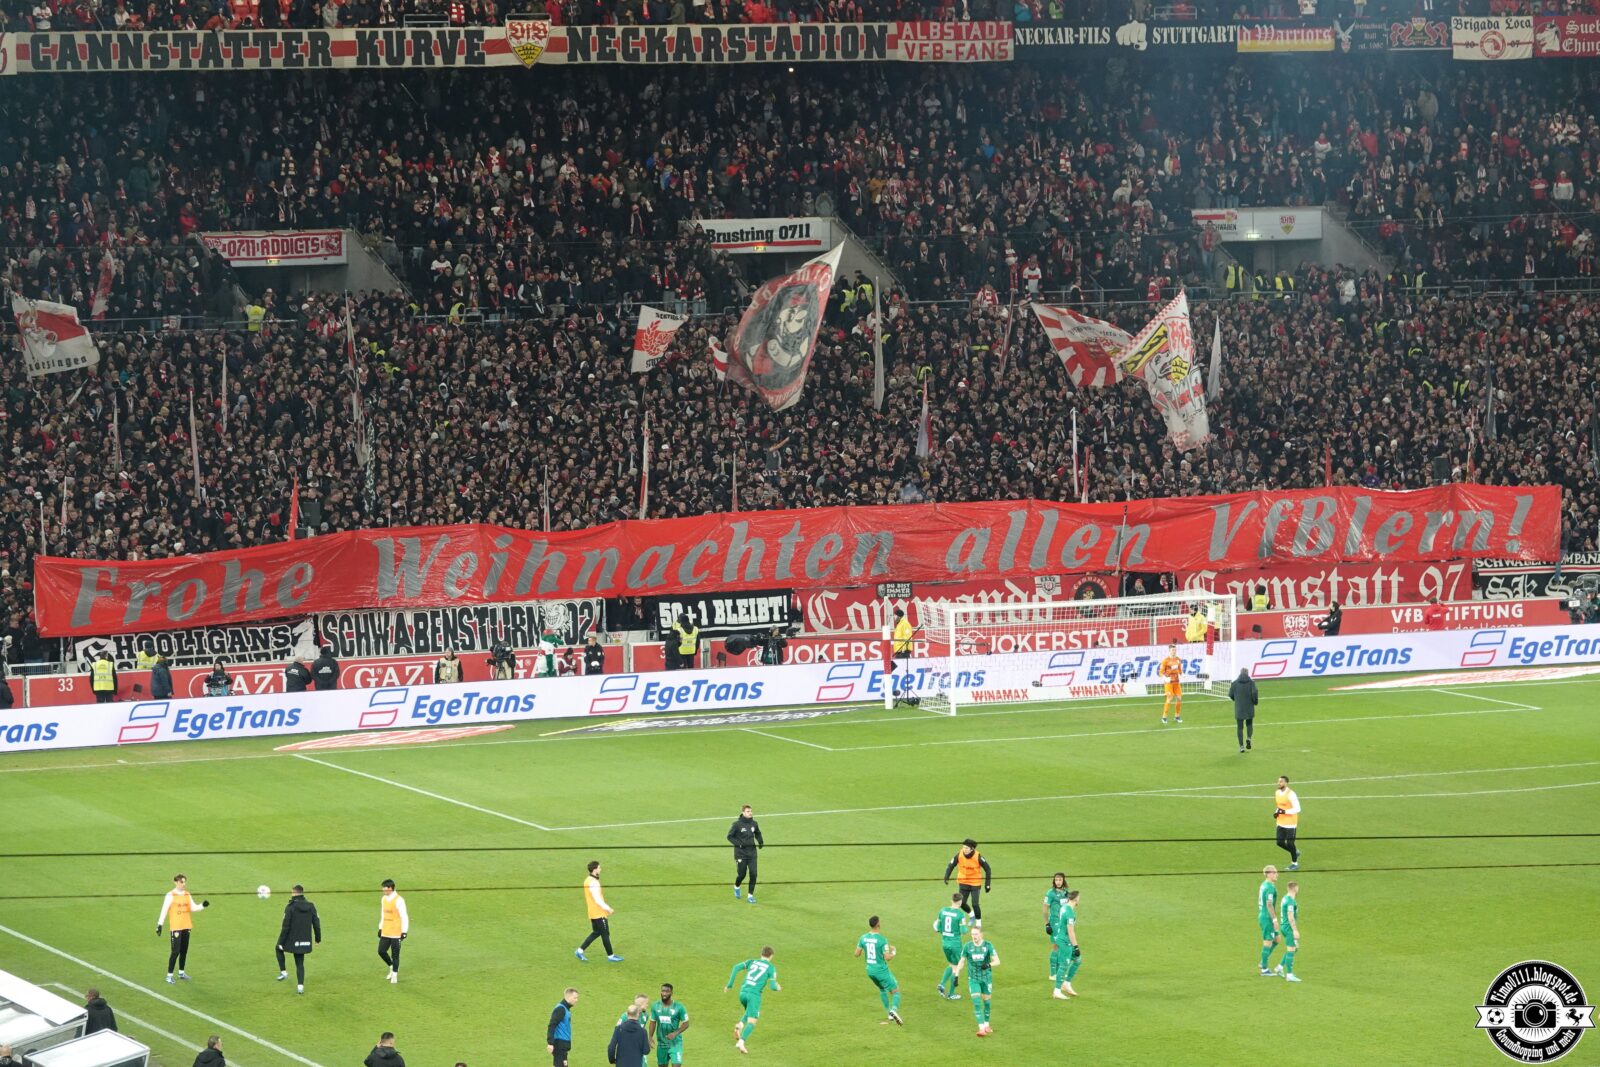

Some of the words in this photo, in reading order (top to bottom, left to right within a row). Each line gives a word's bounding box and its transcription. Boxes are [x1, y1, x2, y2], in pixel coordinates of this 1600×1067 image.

[902, 21, 1013, 40] ALBSTADT
[1015, 26, 1110, 46] NECKAR-FILS
[1152, 25, 1237, 44] STUTTGART
[1255, 23, 1332, 45] Warriors
[1453, 18, 1500, 32] Brigada
[1505, 18, 1533, 30] Loca
[31, 31, 332, 71] CANNSTATTER
[356, 29, 486, 66] KURVE
[566, 25, 889, 62] NECKARSTADION
[904, 41, 1009, 60] VFB-FANS
[705, 227, 774, 243] Brustring
[779, 223, 810, 239] 0711
[228, 239, 256, 257] 0711
[261, 237, 320, 255] ADDICTS
[71, 559, 314, 628] Frohe
[374, 521, 894, 600] Weihnachten
[946, 509, 1151, 573] allen
[1208, 495, 1534, 562] VfBlern!
[1184, 567, 1405, 612] Cannstatt
[1418, 564, 1466, 603] 97
[714, 595, 788, 625] BLEIBT!
[1391, 608, 1424, 623] VfB
[1445, 605, 1524, 621] TIFTUNG
[321, 604, 545, 658] SCHWABENSTURM
[565, 601, 595, 645] 02
[112, 625, 292, 659] HOOLIGANS
[785, 641, 930, 664] JOKERSR
[989, 629, 1129, 654] JOKERSTAR
[1087, 656, 1204, 685] EgeTrns
[1299, 644, 1413, 675] EgeTrans
[58, 678, 73, 692] 33
[641, 680, 765, 710] EgeTrans
[971, 689, 1029, 703] WINAMAX
[1069, 684, 1127, 697] WINAMAX
[411, 691, 536, 720] EgeTrans
[173, 706, 302, 738] EgeTrans
[944, 916, 952, 932] 8
[747, 963, 767, 982] 27
